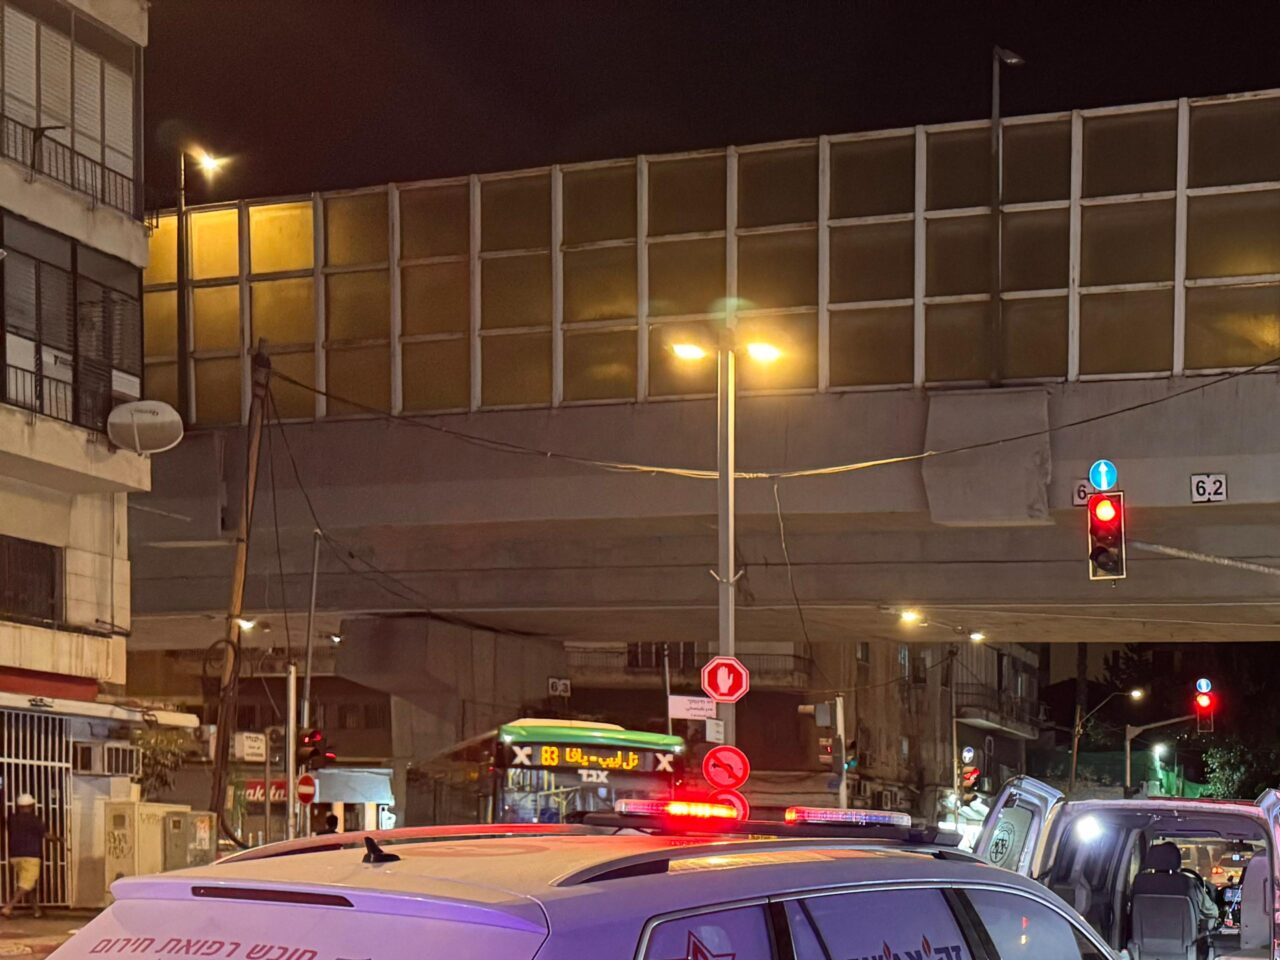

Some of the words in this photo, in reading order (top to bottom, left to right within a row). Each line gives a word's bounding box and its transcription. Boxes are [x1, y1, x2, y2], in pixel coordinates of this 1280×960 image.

[1194, 479, 1224, 497] 6.2
[541, 746, 559, 766] 83
[244, 785, 288, 801] akta
[89, 938, 156, 954] חירום
[155, 938, 241, 958] רפואת
